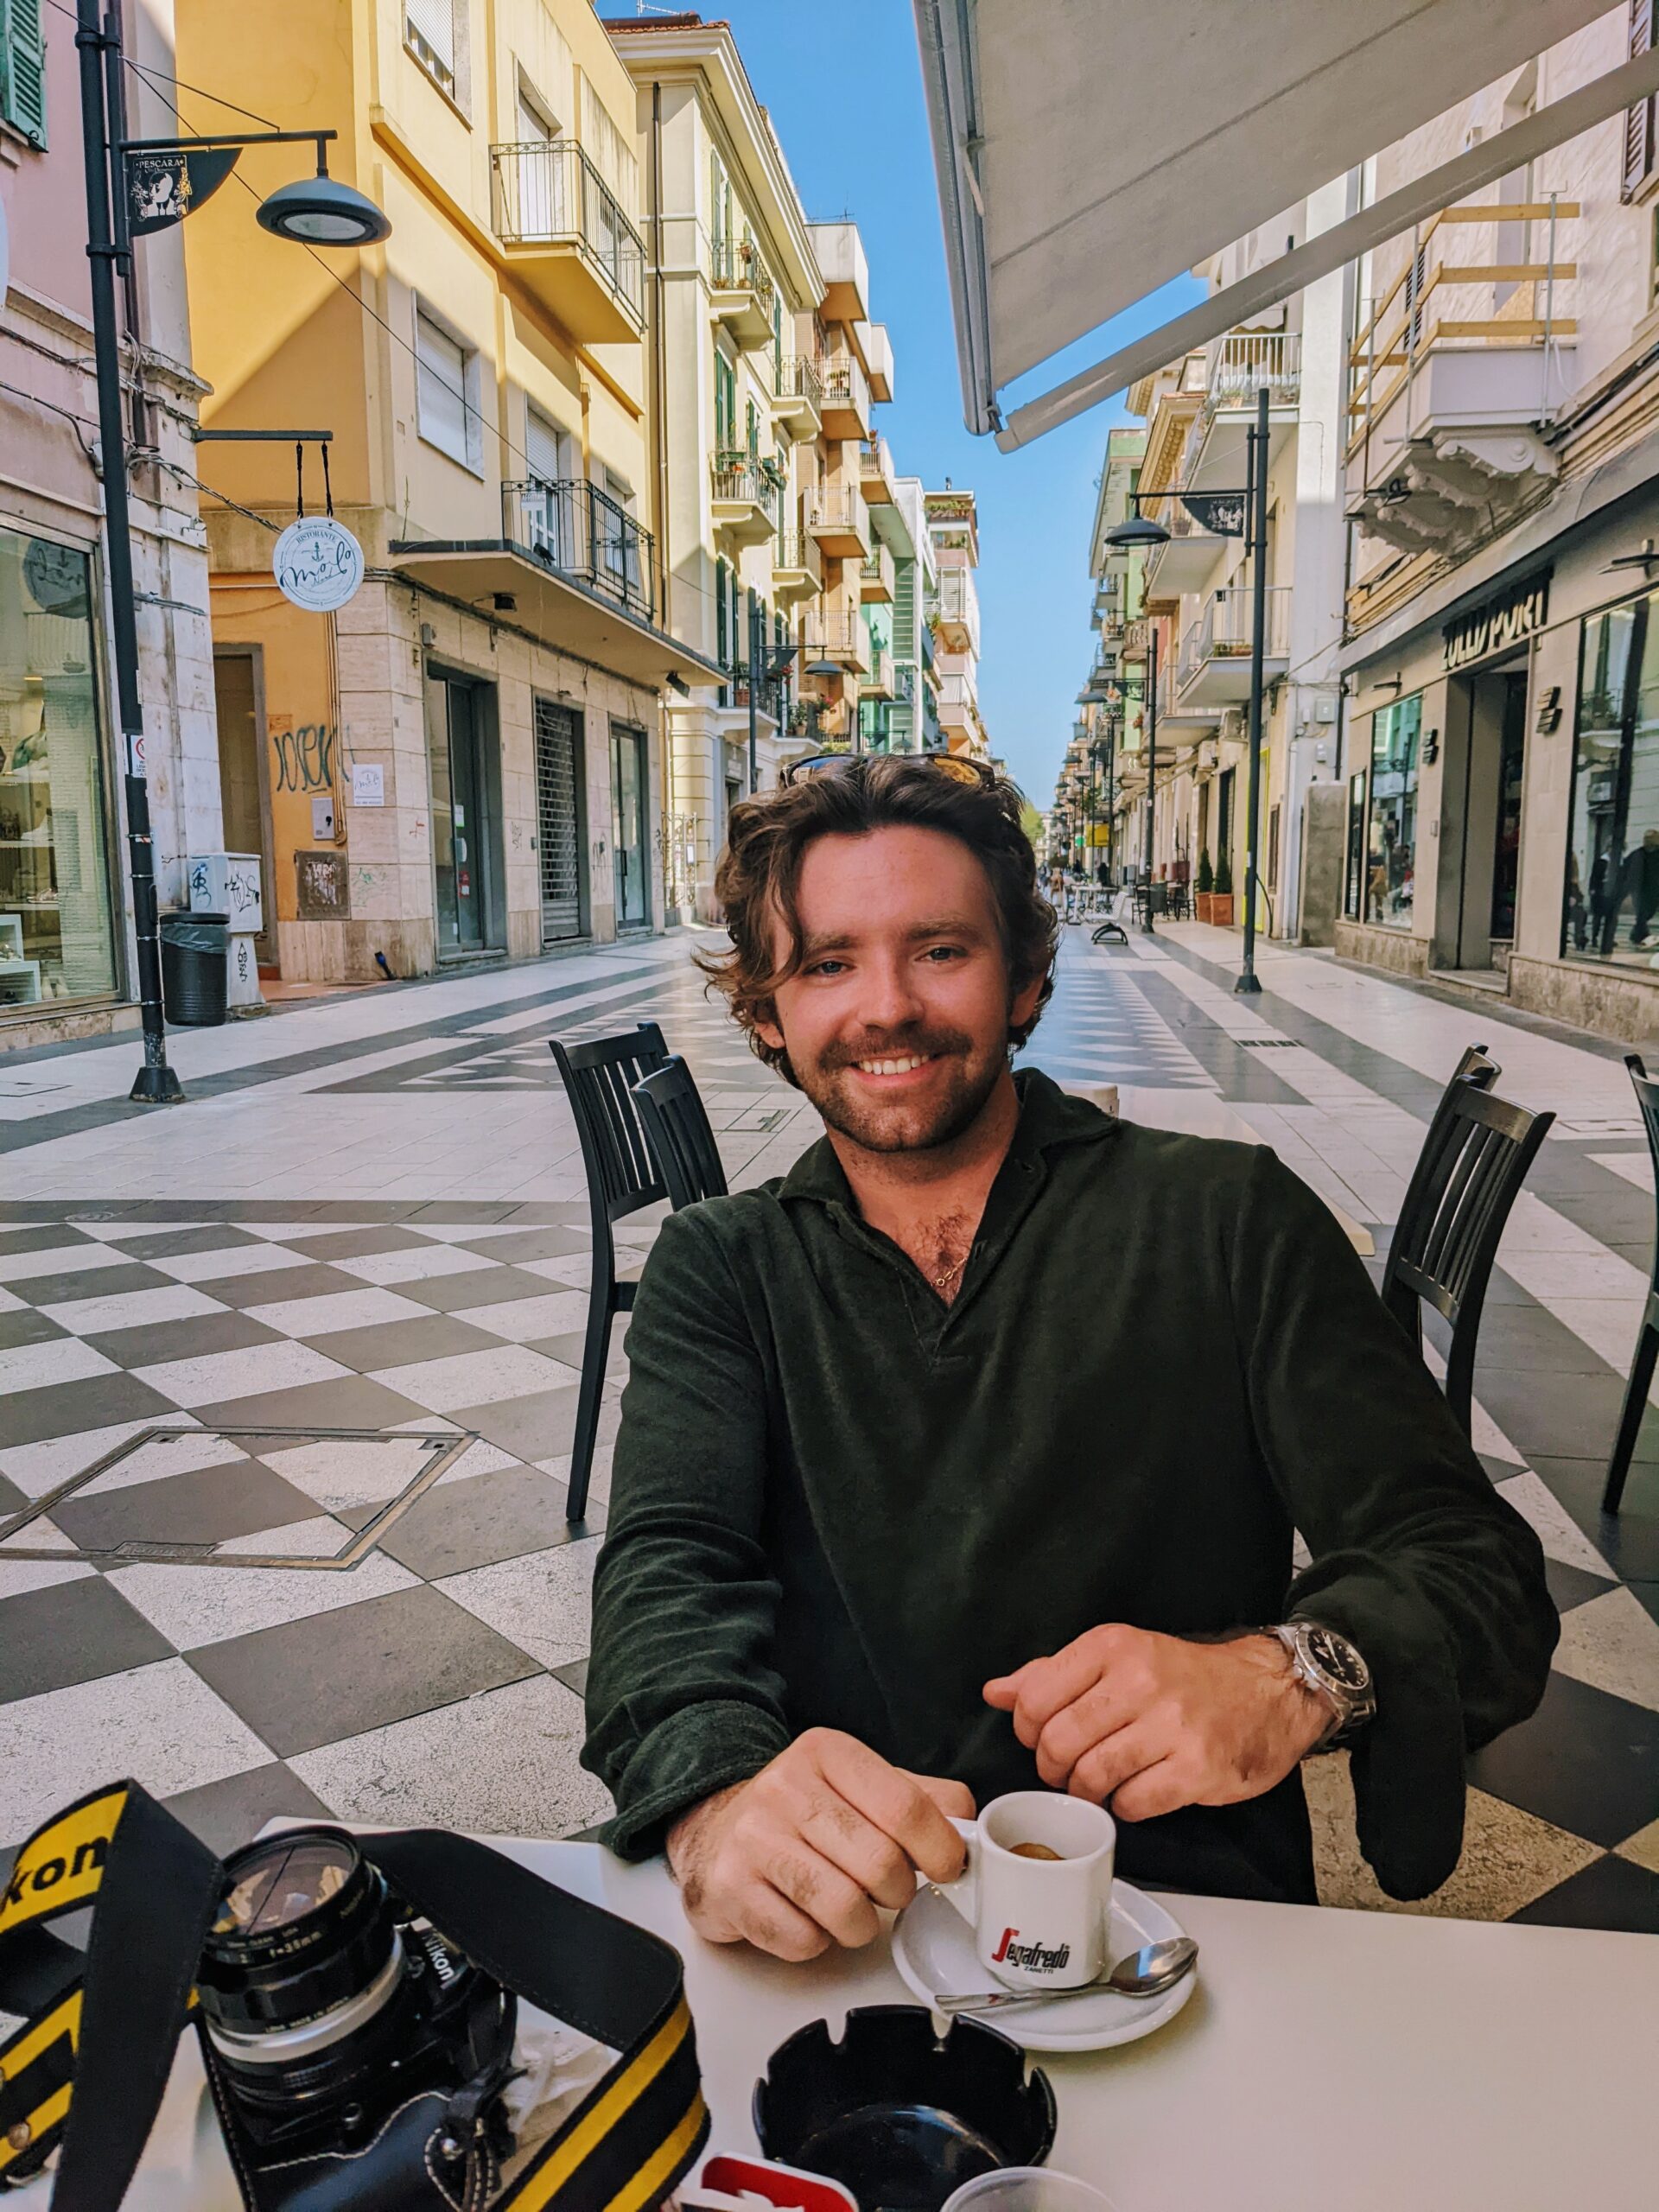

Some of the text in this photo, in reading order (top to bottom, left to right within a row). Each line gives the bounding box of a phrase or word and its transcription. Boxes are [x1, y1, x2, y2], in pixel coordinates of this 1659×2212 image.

[138, 159, 181, 168] PESCARA
[296, 530, 337, 543] RISTORANTE
[991, 1927, 1071, 1968] Segafredo
[421, 1931, 455, 1980] Nikon
[1024, 1965, 1054, 1975] ZANETTI
